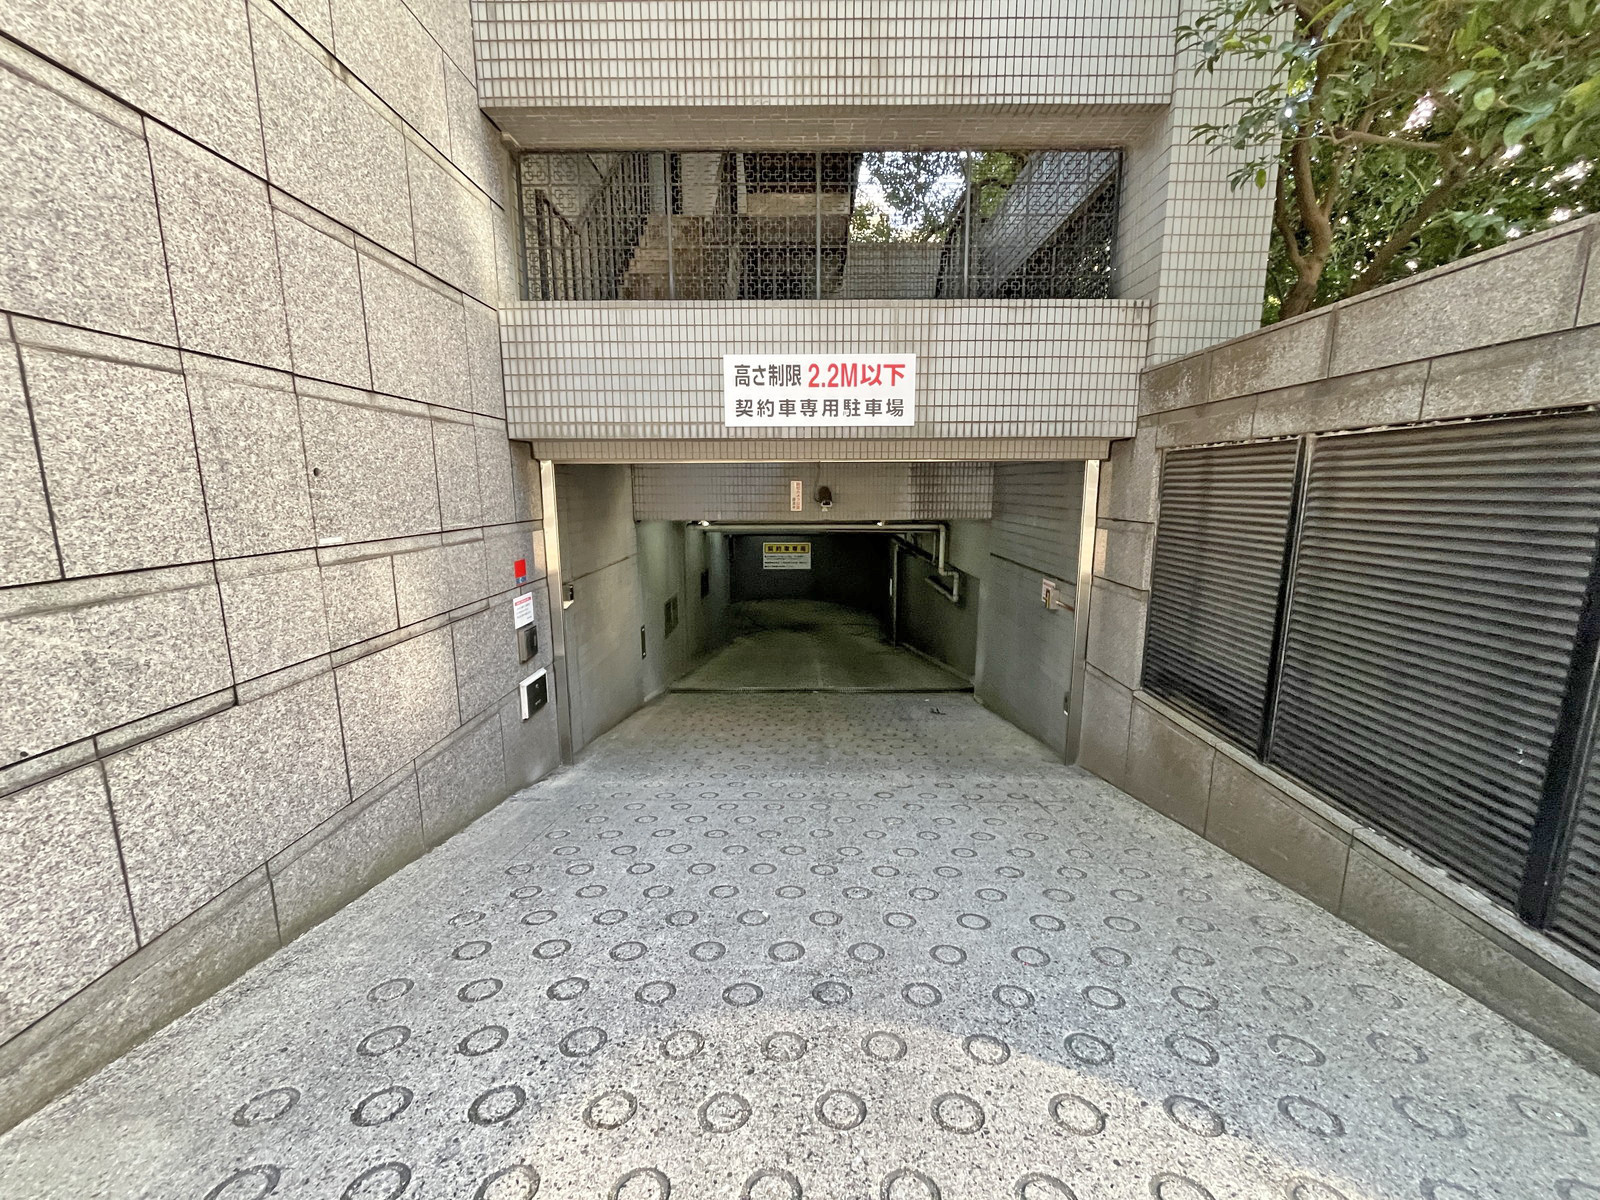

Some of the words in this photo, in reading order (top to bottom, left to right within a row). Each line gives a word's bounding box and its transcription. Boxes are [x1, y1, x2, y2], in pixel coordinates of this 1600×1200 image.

[734, 364, 802, 387] 高さ制限
[808, 362, 906, 388] 2.2M以下
[735, 398, 905, 417] 契約車専用駐車場
